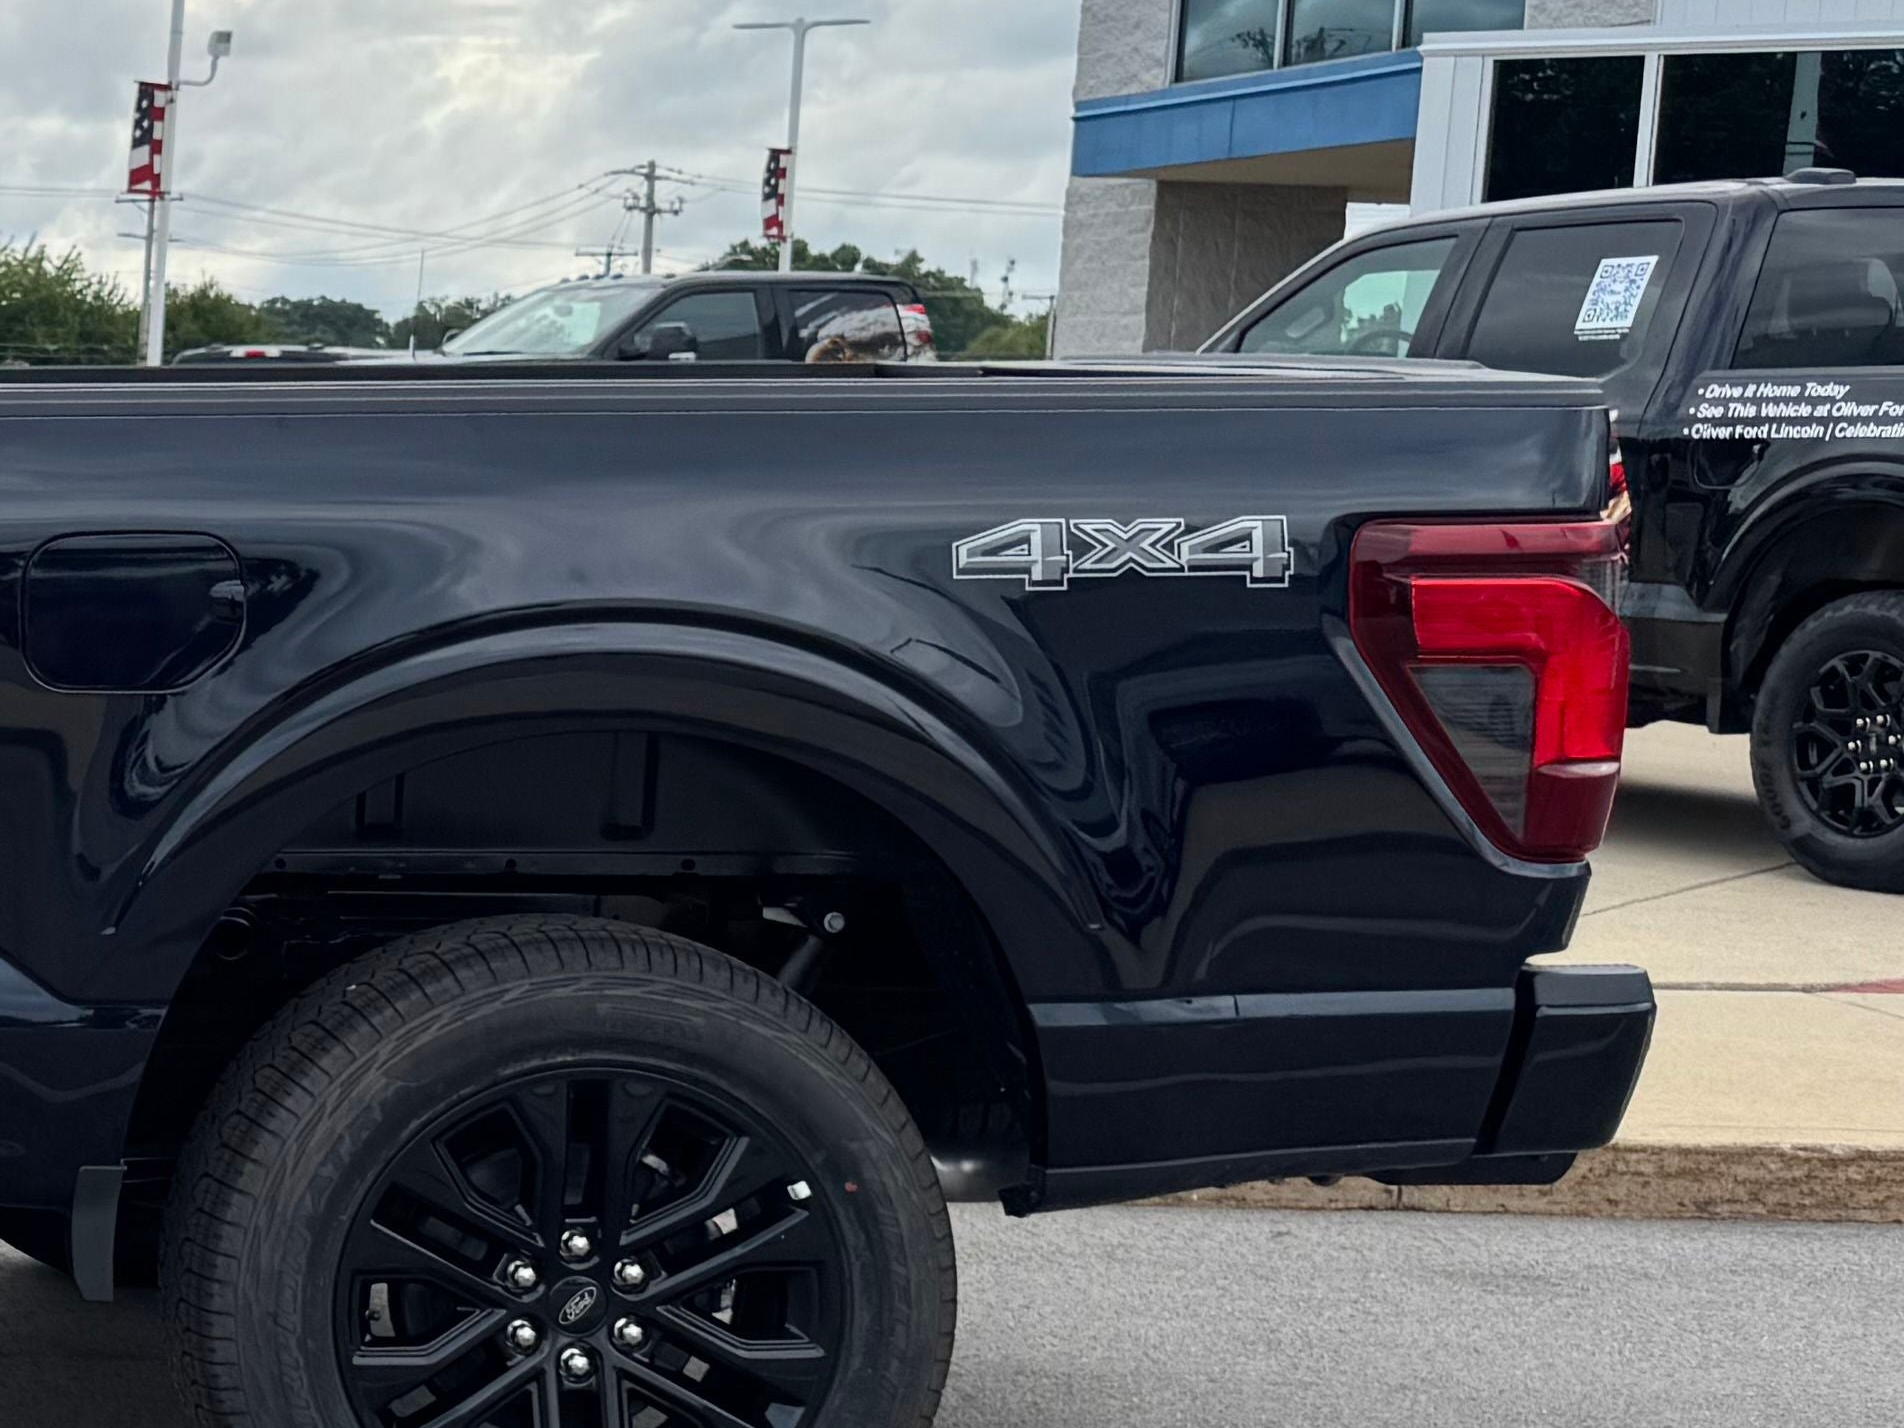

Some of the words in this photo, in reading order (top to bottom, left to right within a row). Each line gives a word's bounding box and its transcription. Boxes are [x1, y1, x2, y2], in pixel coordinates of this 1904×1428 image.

[1757, 382, 1801, 397] Home
[1804, 381, 1850, 400] Today
[1697, 403, 1724, 418] See
[1727, 403, 1757, 418] This
[1760, 402, 1812, 418] Vehicle
[1813, 403, 1831, 417] at
[1831, 401, 1879, 417] Oliver
[1691, 423, 1733, 440] Oliver
[1735, 423, 1769, 439] Ford
[1771, 422, 1824, 439] Lincoln
[953, 515, 1294, 591] 4X4
